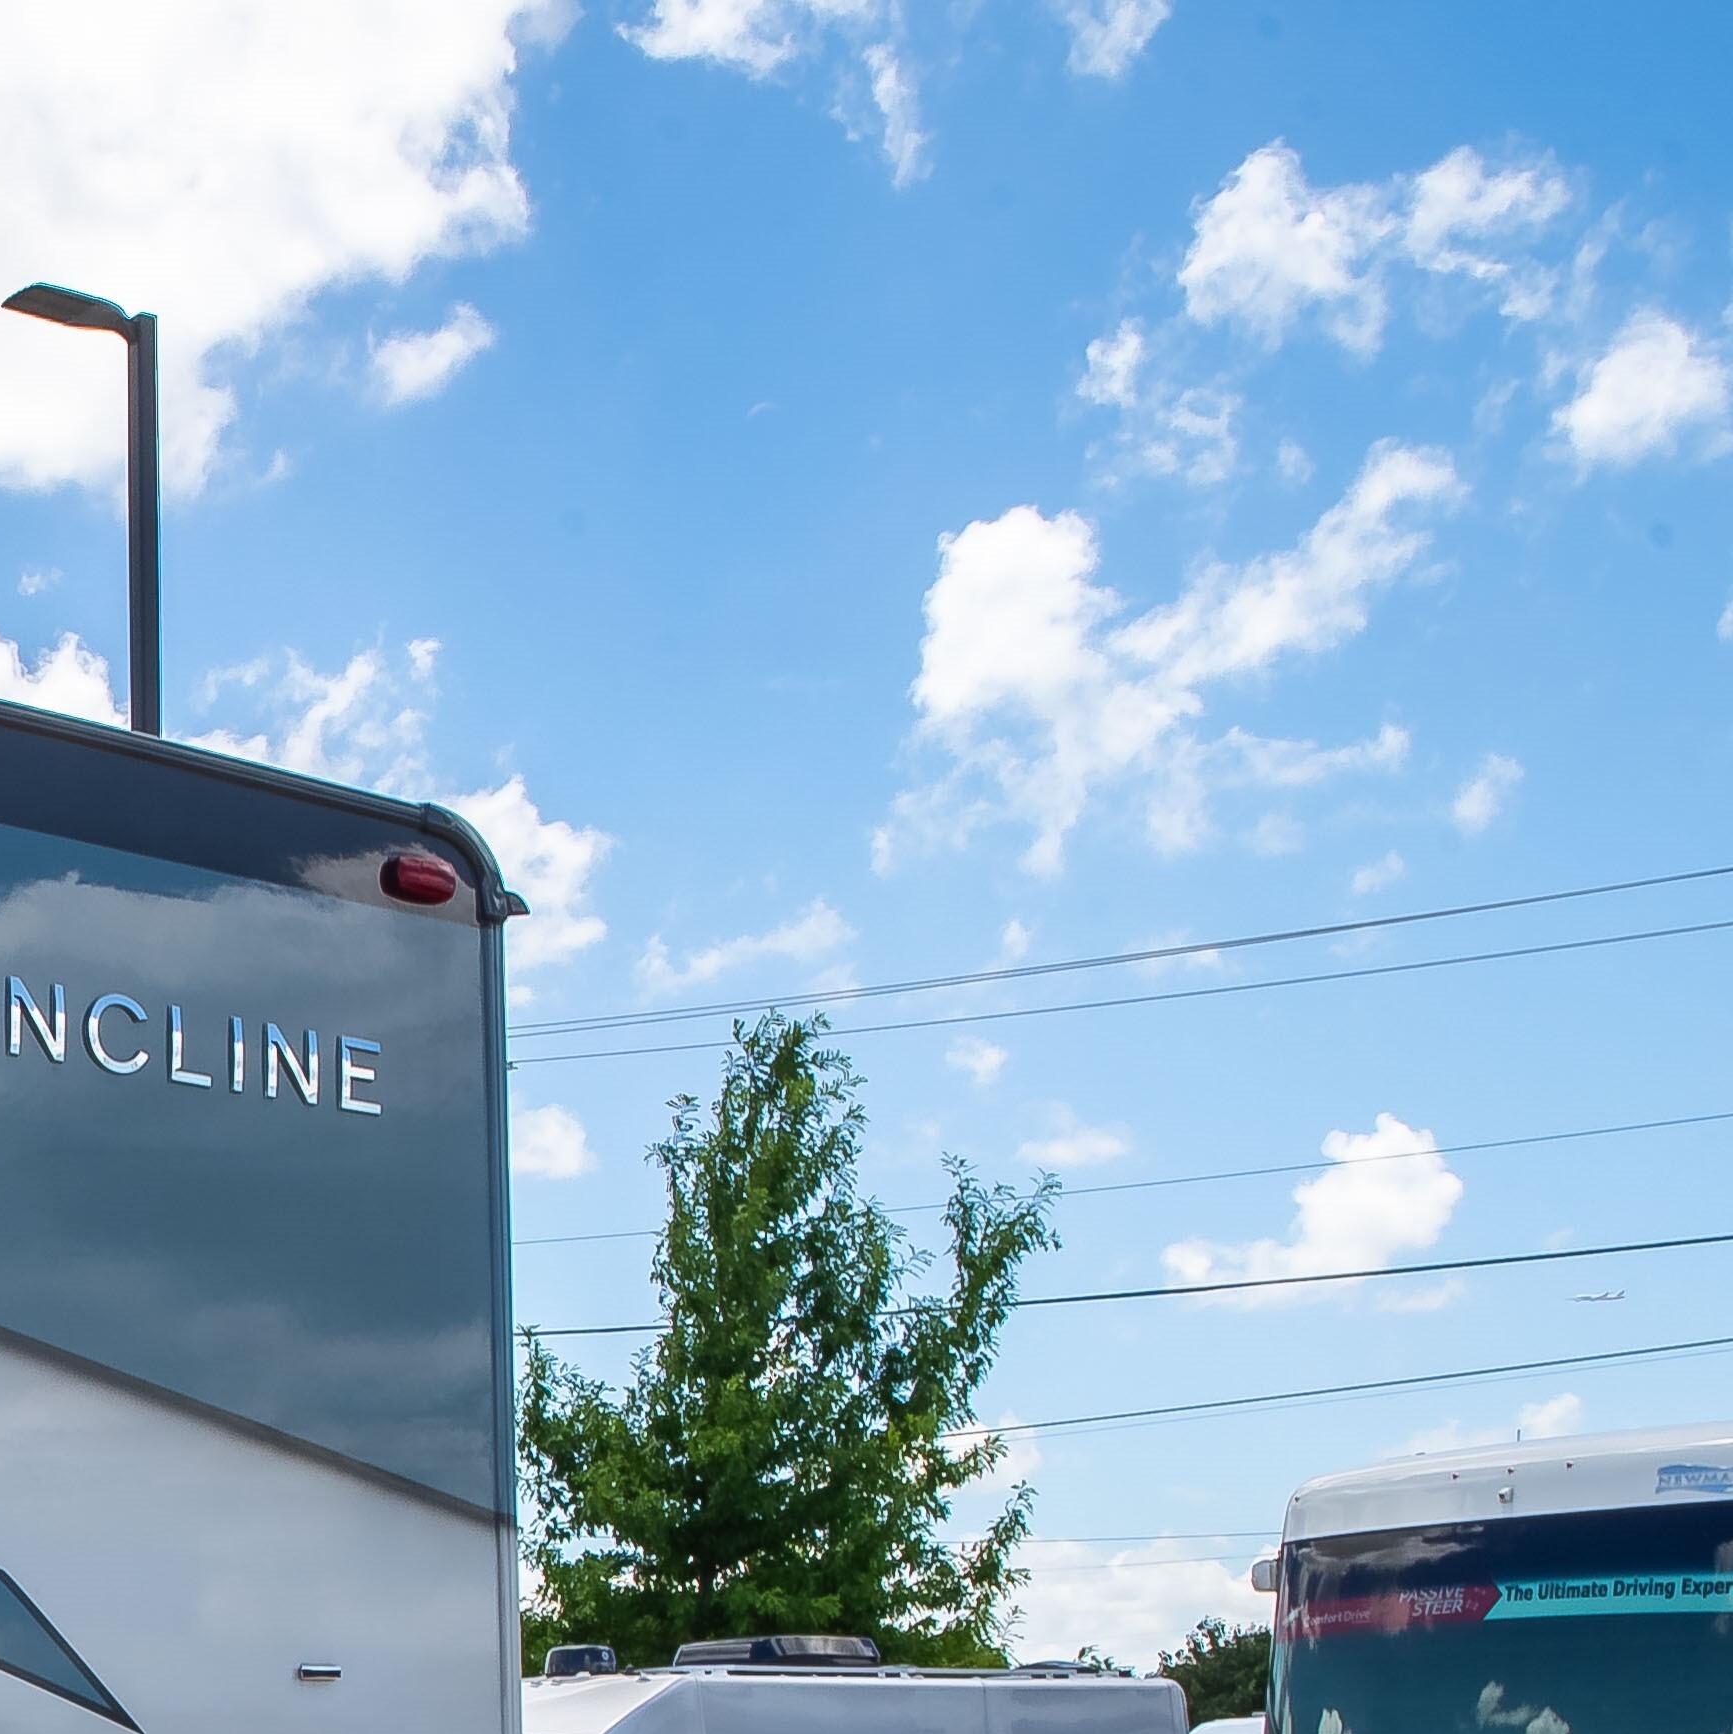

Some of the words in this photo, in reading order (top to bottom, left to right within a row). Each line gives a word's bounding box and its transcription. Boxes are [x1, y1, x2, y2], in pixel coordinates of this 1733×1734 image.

[1399, 1587, 1465, 1604] PASSIVE
[1504, 1584, 1533, 1602] The
[1537, 1581, 1608, 1600] Ultimate
[1613, 1578, 1675, 1598] Driving
[1412, 1600, 1463, 1617] STEER
